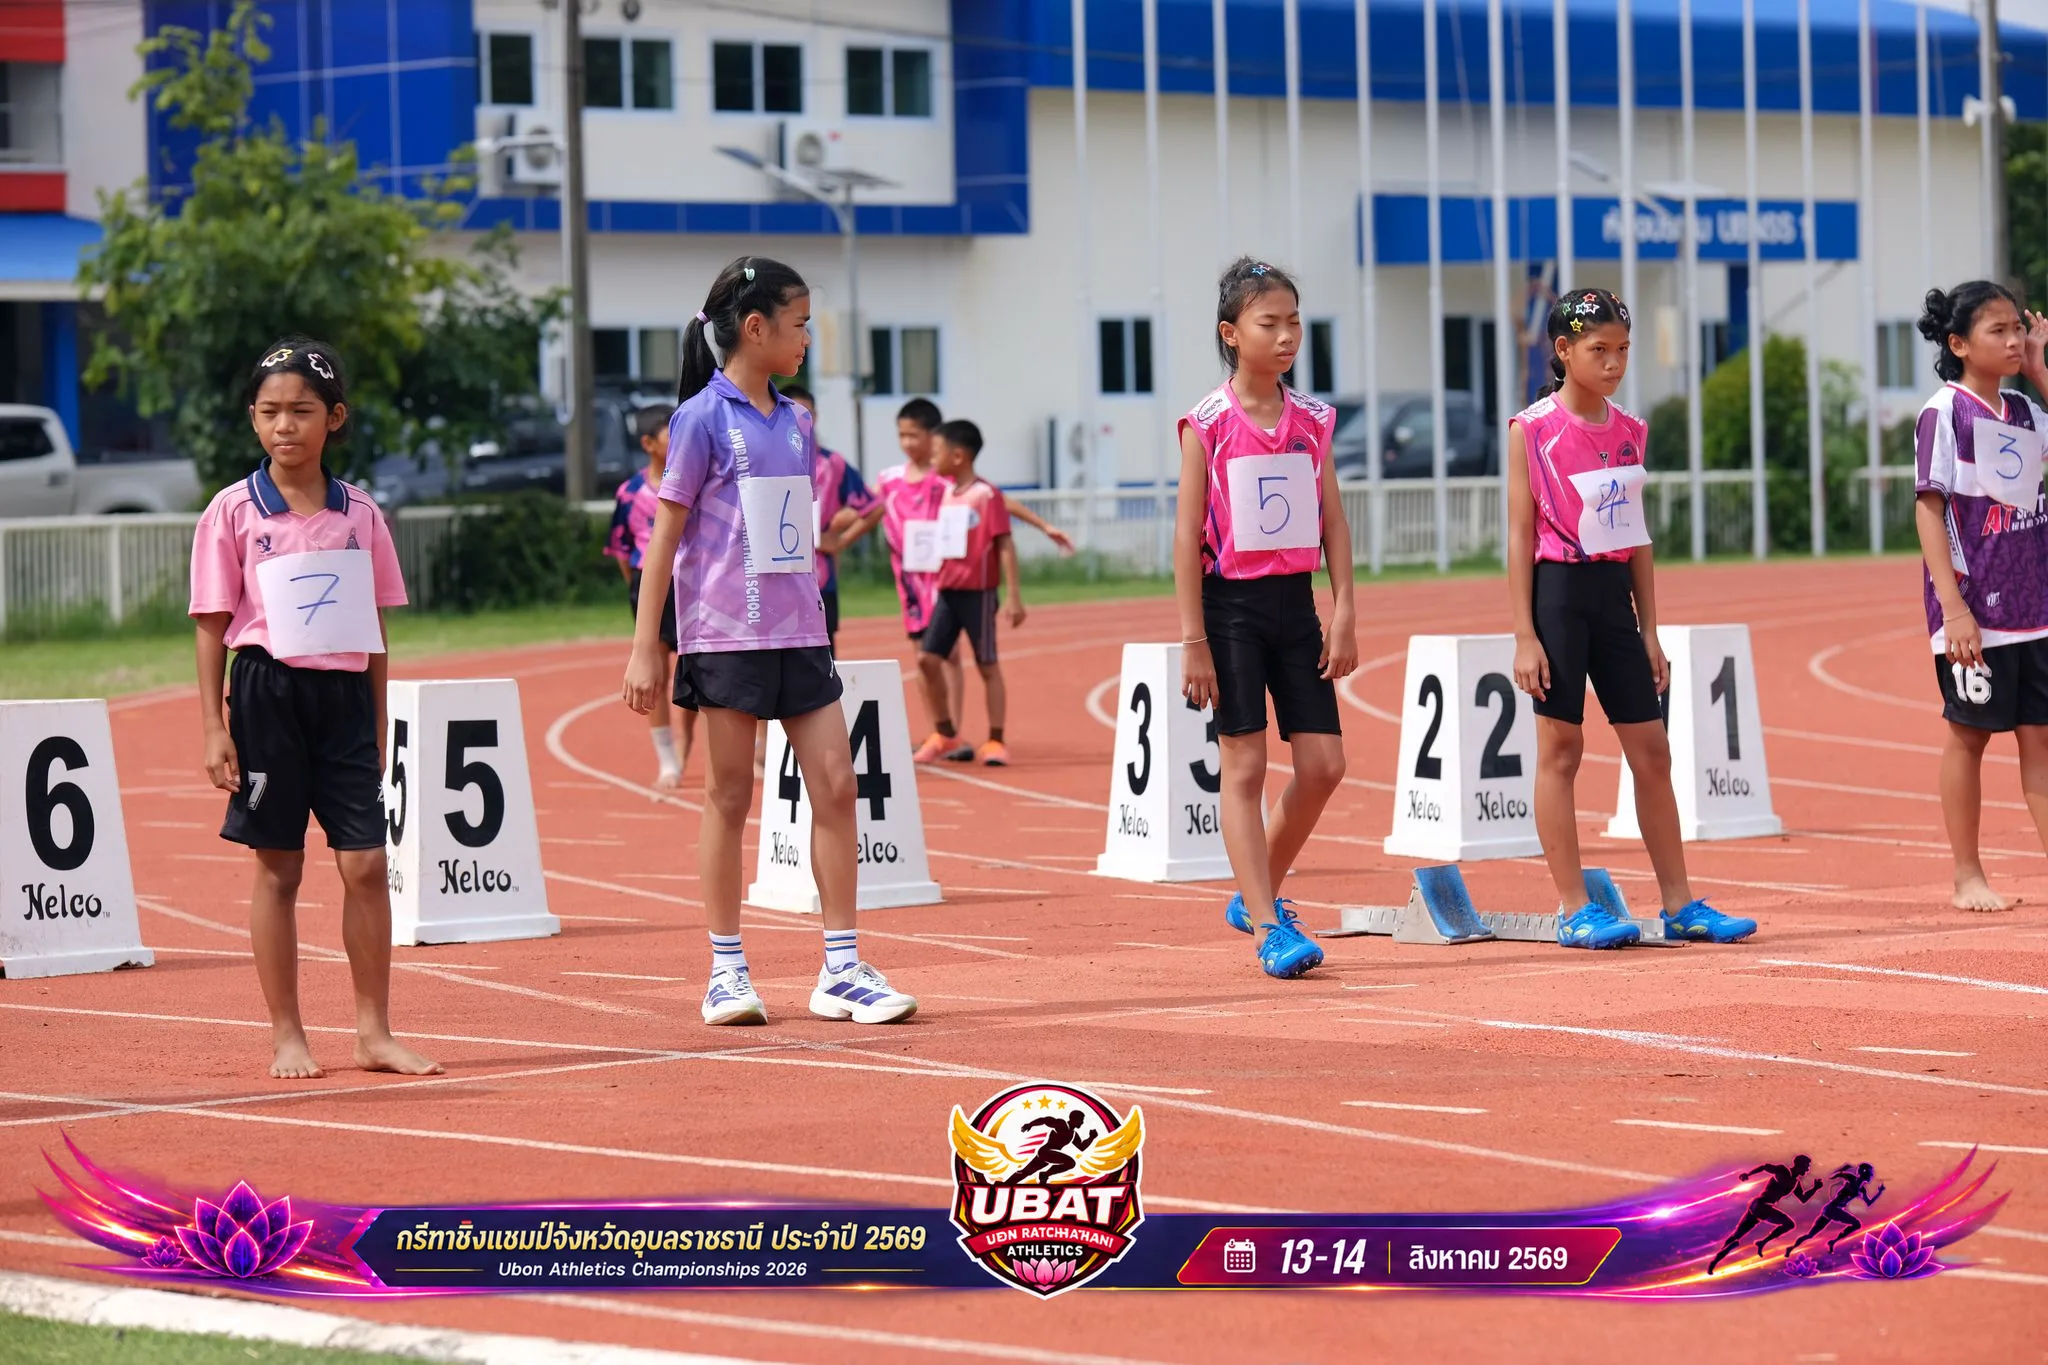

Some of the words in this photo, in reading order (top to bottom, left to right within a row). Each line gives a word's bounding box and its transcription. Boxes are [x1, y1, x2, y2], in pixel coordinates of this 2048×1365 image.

[728, 428, 750, 471] ANUBAN
[1996, 432, 2023, 480] 3
[776, 489, 802, 558] 6
[1257, 476, 1290, 535] 5
[1596, 478, 1629, 530] 4
[289, 573, 341, 626] 7
[745, 579, 761, 626] SCHOOL
[1952, 660, 1993, 705] 16
[1414, 674, 1444, 780] 2
[1474, 673, 1523, 780] 2
[1711, 656, 1741, 761] 1
[848, 700, 892, 821] 4
[1127, 682, 1152, 796] 3
[25, 736, 95, 871] 6
[248, 771, 268, 811] 7
[389, 719, 408, 847] 5
[444, 719, 505, 848] 5
[1408, 790, 1441, 823] Nelco
[1705, 768, 1750, 798] Nelco
[1118, 803, 1149, 838] Nelco
[1185, 803, 1219, 836] Nel
[1475, 792, 1528, 823] Nelco
[771, 831, 800, 867] Nelco
[387, 857, 404, 895] elco
[438, 859, 512, 894] Nelco
[21, 882, 102, 921] Nelco
